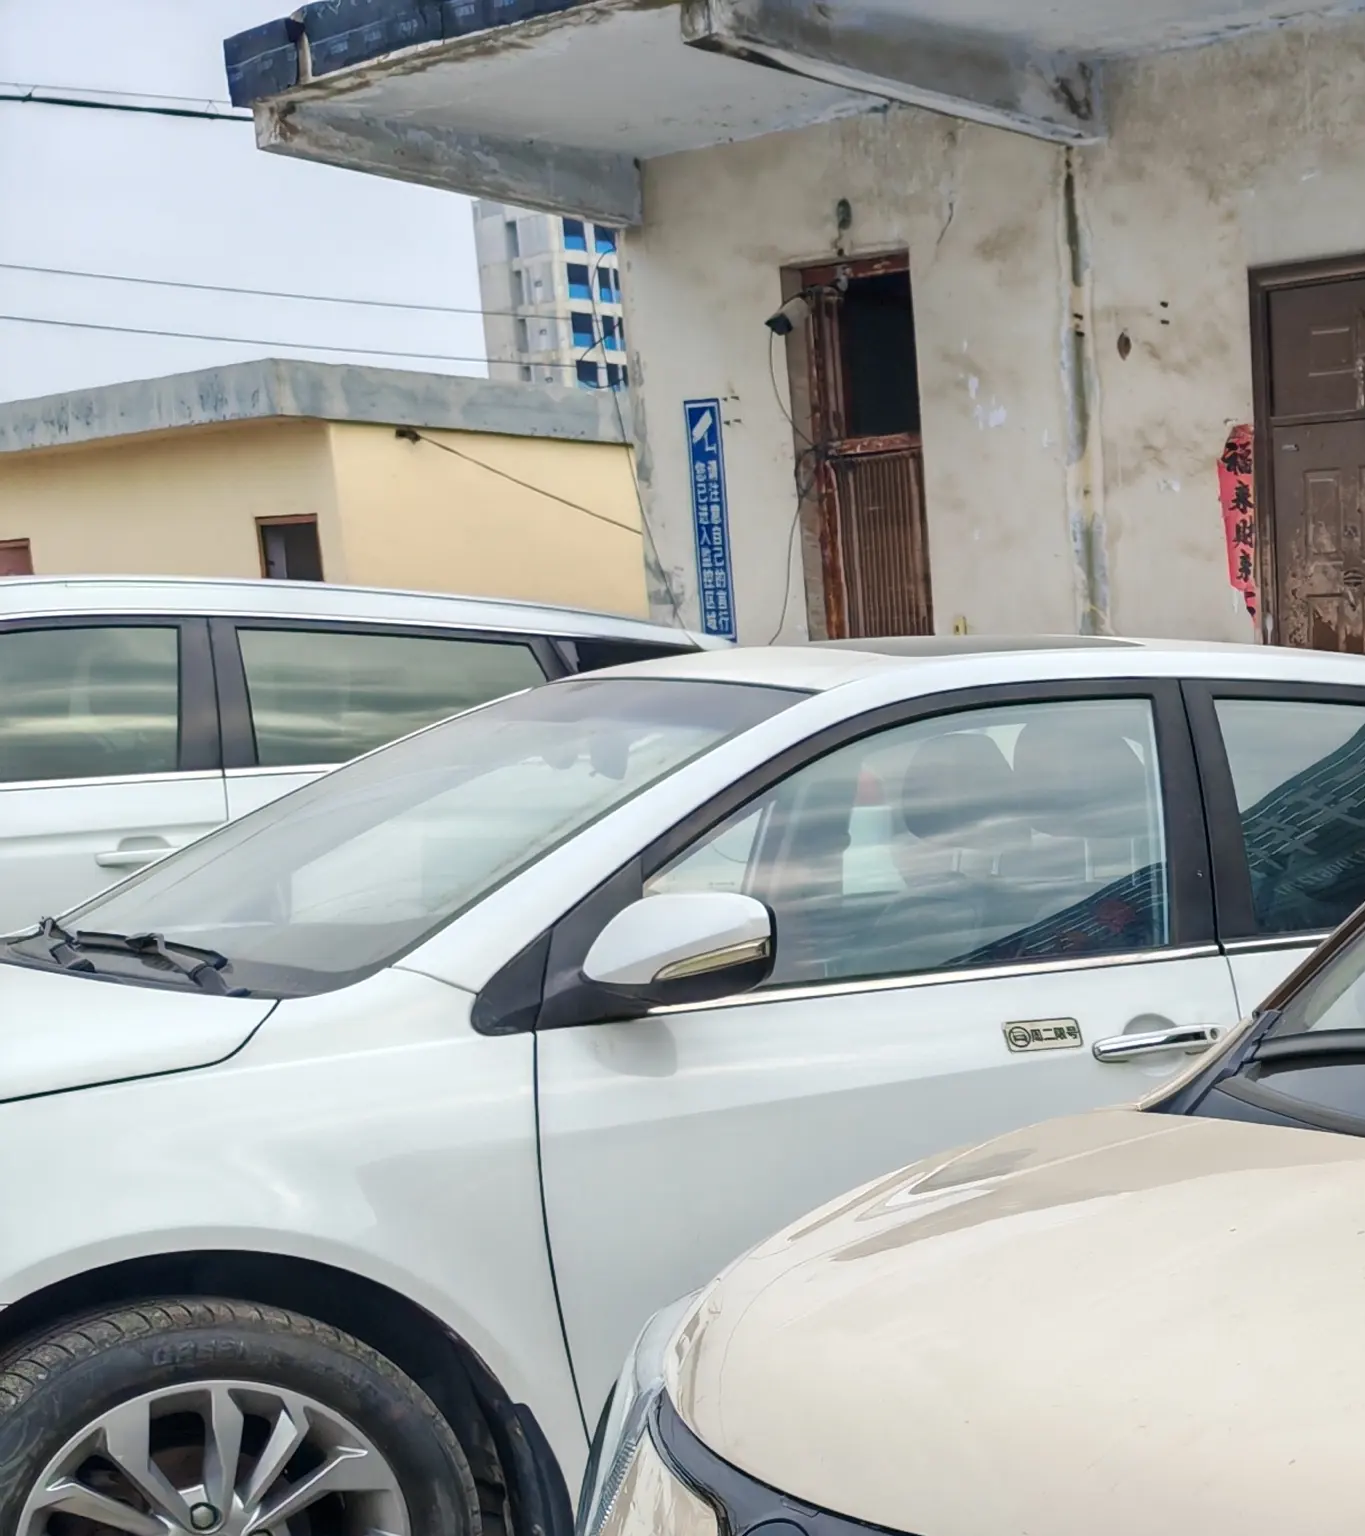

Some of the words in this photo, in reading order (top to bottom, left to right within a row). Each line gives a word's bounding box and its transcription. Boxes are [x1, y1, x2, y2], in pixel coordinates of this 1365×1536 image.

[695, 460, 718, 631] 您已进入监控区域
